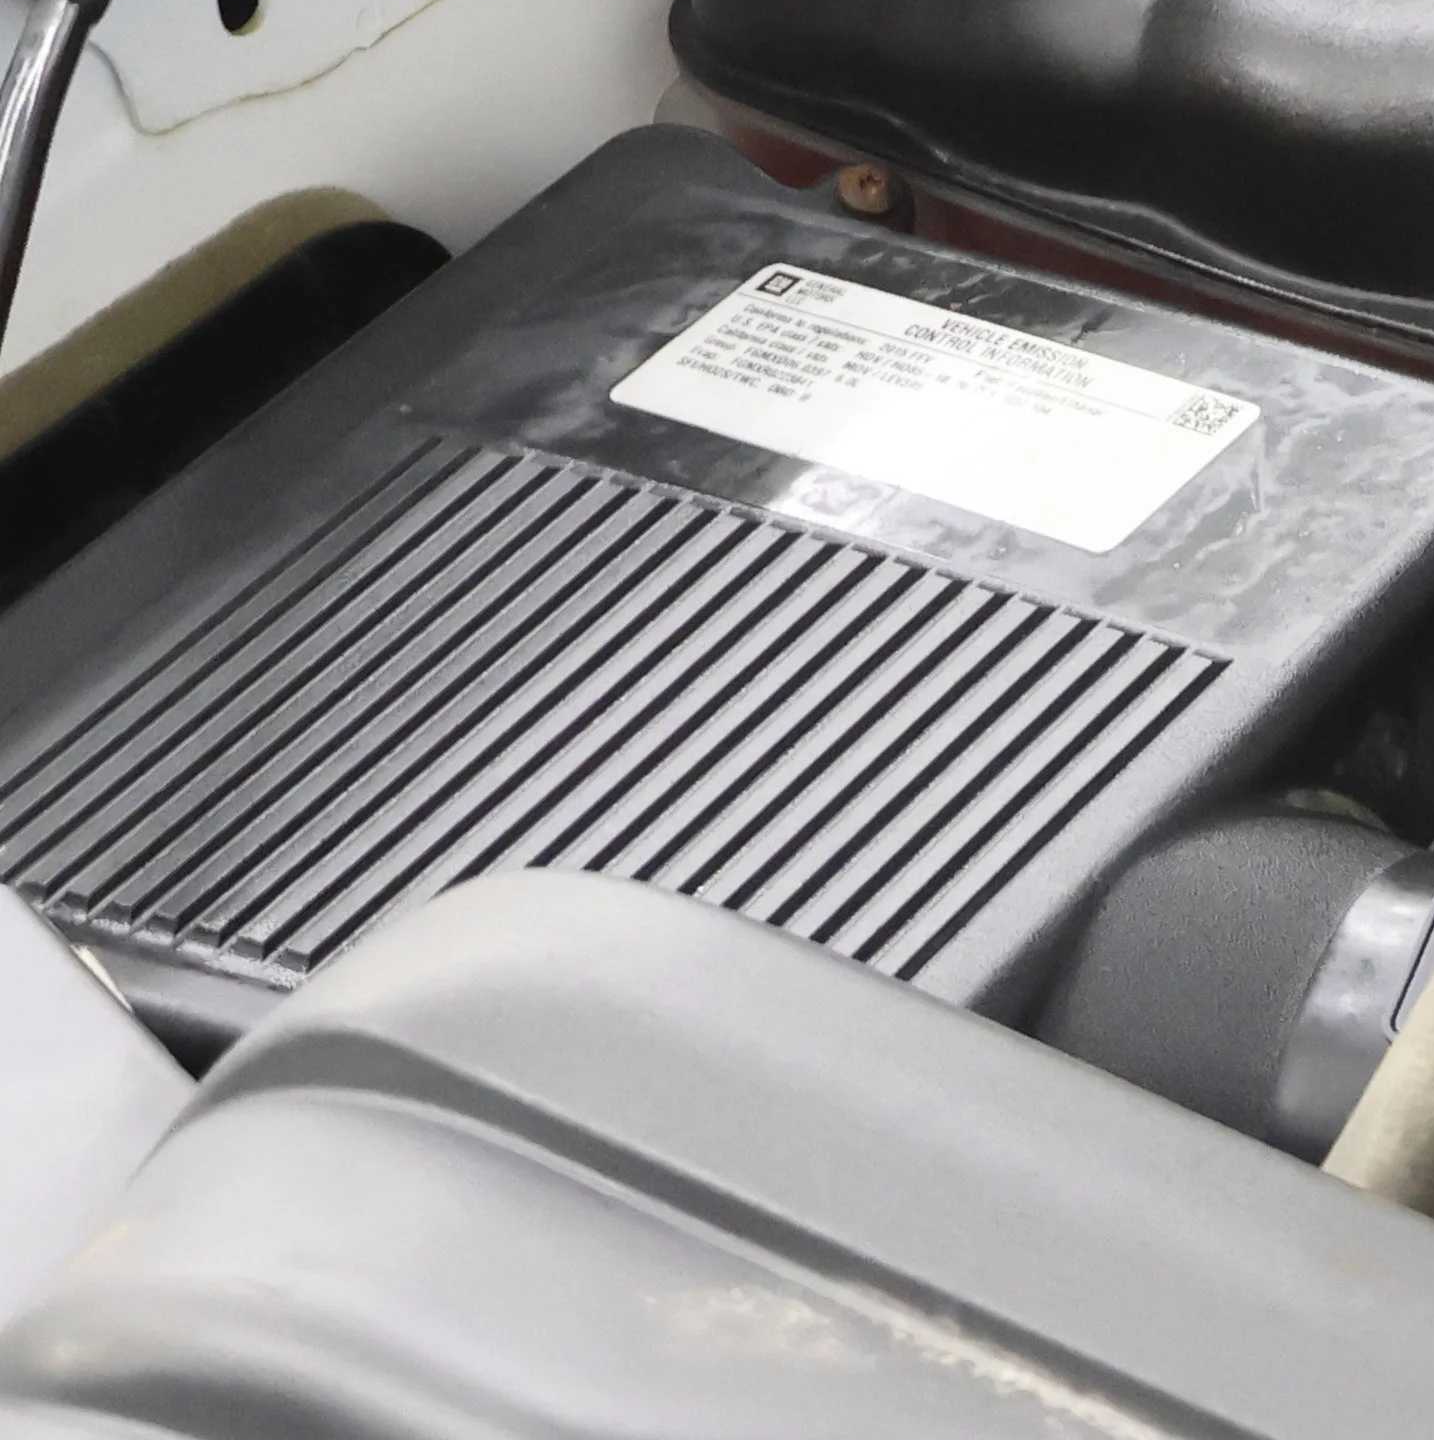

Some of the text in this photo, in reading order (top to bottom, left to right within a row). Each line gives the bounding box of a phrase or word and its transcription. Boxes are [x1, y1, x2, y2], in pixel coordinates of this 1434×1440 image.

[903, 323, 1092, 388] CONTROL INFORMATION
[939, 318, 1087, 370] VEHICLE EMISSION
